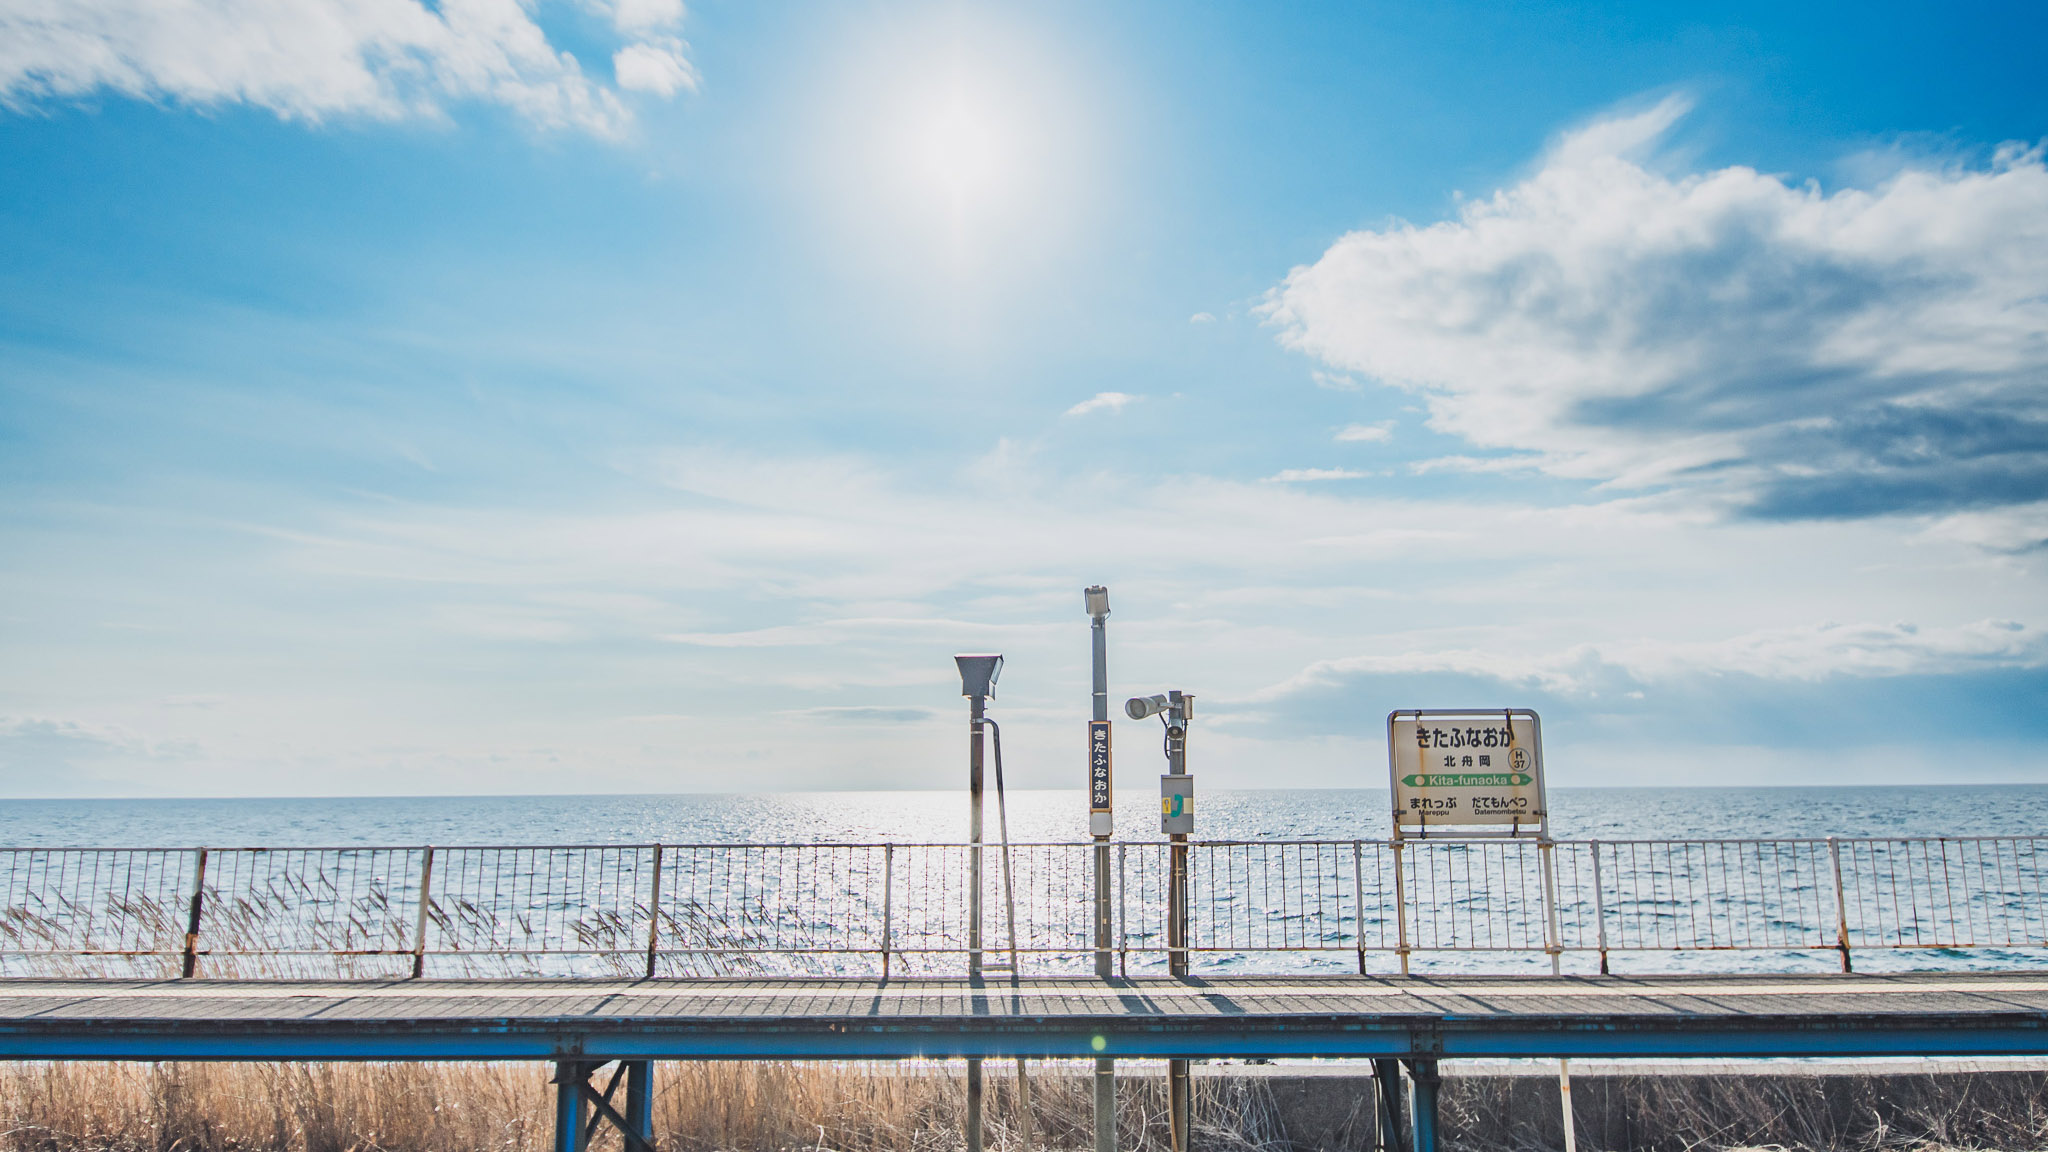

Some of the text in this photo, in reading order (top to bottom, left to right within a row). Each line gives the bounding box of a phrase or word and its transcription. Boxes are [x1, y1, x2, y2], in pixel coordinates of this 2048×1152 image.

[1416, 727, 1515, 748] きたふなおか
[1515, 751, 1523, 759] H
[1094, 729, 1107, 804] きたふなおか
[1444, 755, 1491, 767] 北舟岡
[1514, 760, 1525, 768] 37
[1429, 775, 1508, 786] Kita-funaoka
[1472, 797, 1528, 808] だてもんべつ
